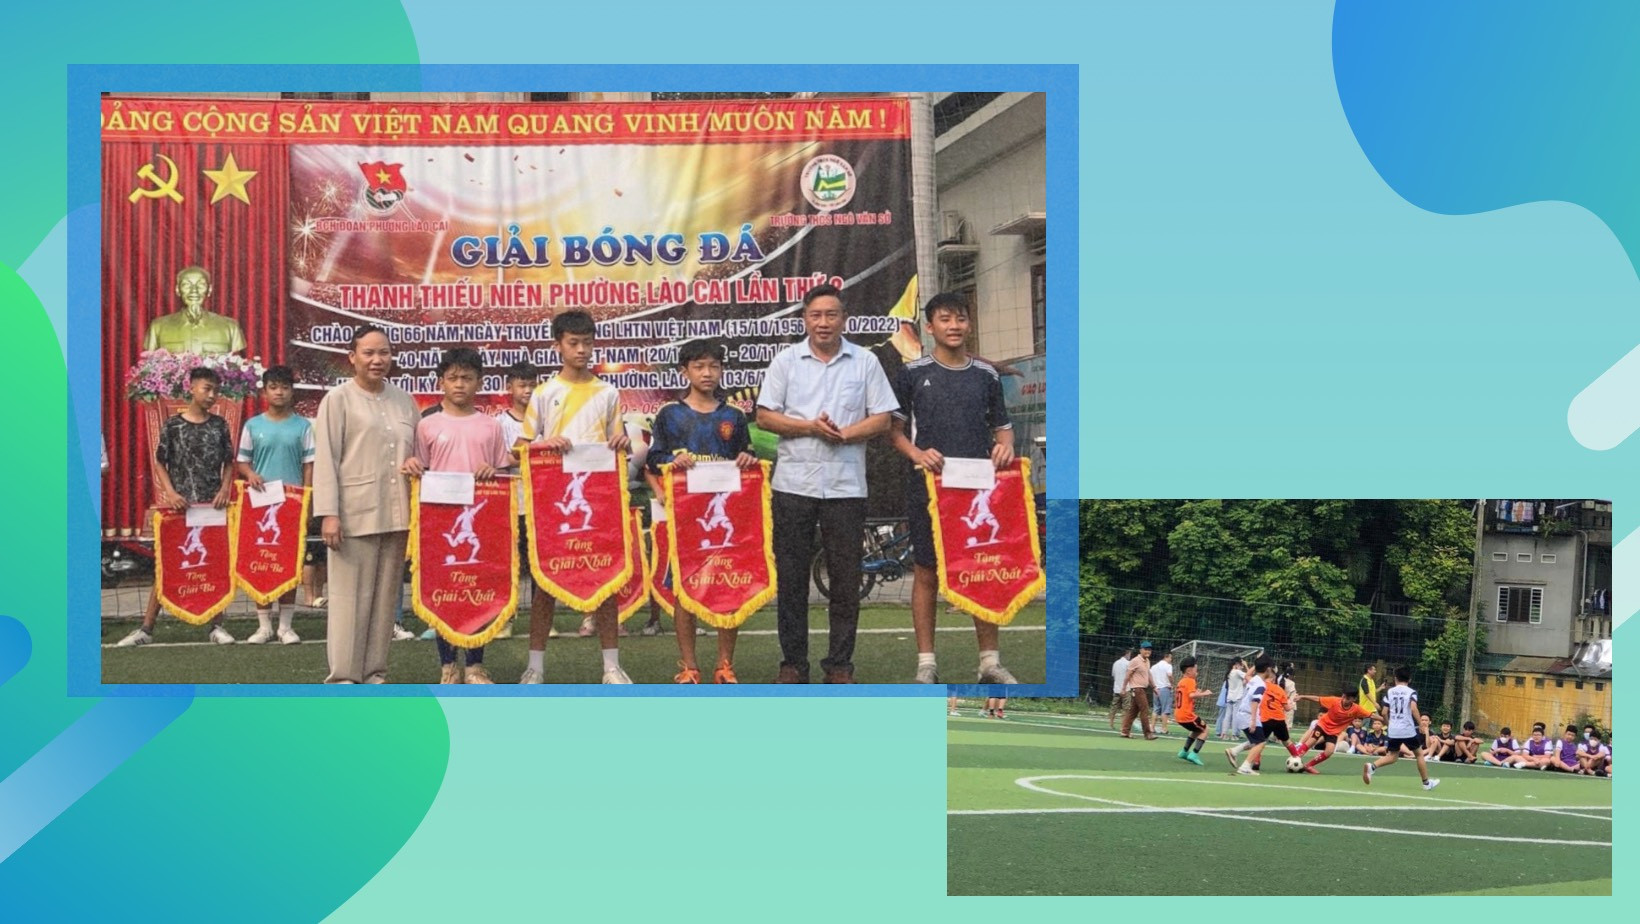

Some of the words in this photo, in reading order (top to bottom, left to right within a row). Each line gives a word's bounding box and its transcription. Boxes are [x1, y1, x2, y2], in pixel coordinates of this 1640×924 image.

[183, 105, 271, 138] CỘNG
[279, 103, 340, 135] SẢN
[351, 107, 422, 140] VIỆT
[430, 114, 498, 135] NAM
[507, 113, 615, 136] QUANG
[624, 112, 700, 134] VINH
[709, 104, 796, 133] MUÔN
[805, 105, 873, 130] NĂM
[452, 222, 551, 268] GIẢI
[562, 224, 688, 265] BÓNG
[698, 223, 766, 263] ĐÁ
[339, 284, 414, 310] THANH
[420, 276, 483, 309] THIẾU
[490, 278, 543, 307] NIÊN
[549, 278, 642, 307] PHƯỜNG
[646, 275, 689, 305] LÀO
[693, 279, 733, 304] CAI
[735, 271, 778, 303] LẦN
[312, 322, 353, 343] CHÀO
[403, 326, 421, 342] 66
[425, 321, 459, 342] NĂM
[463, 321, 501, 342] NGÀY
[506, 318, 555, 341] TRUYỀ
[615, 322, 650, 339] LHTN
[654, 318, 685, 341] VIỆT
[687, 320, 722, 338] NAM
[398, 352, 417, 369] 40
[419, 347, 443, 369] NĂ
[478, 346, 498, 367] ÀY
[500, 346, 530, 366] NHÀ
[606, 347, 640, 364] NAM
[483, 375, 501, 392] 30
[1267, 693, 1276, 710] 2
[1393, 696, 1404, 714] 11
